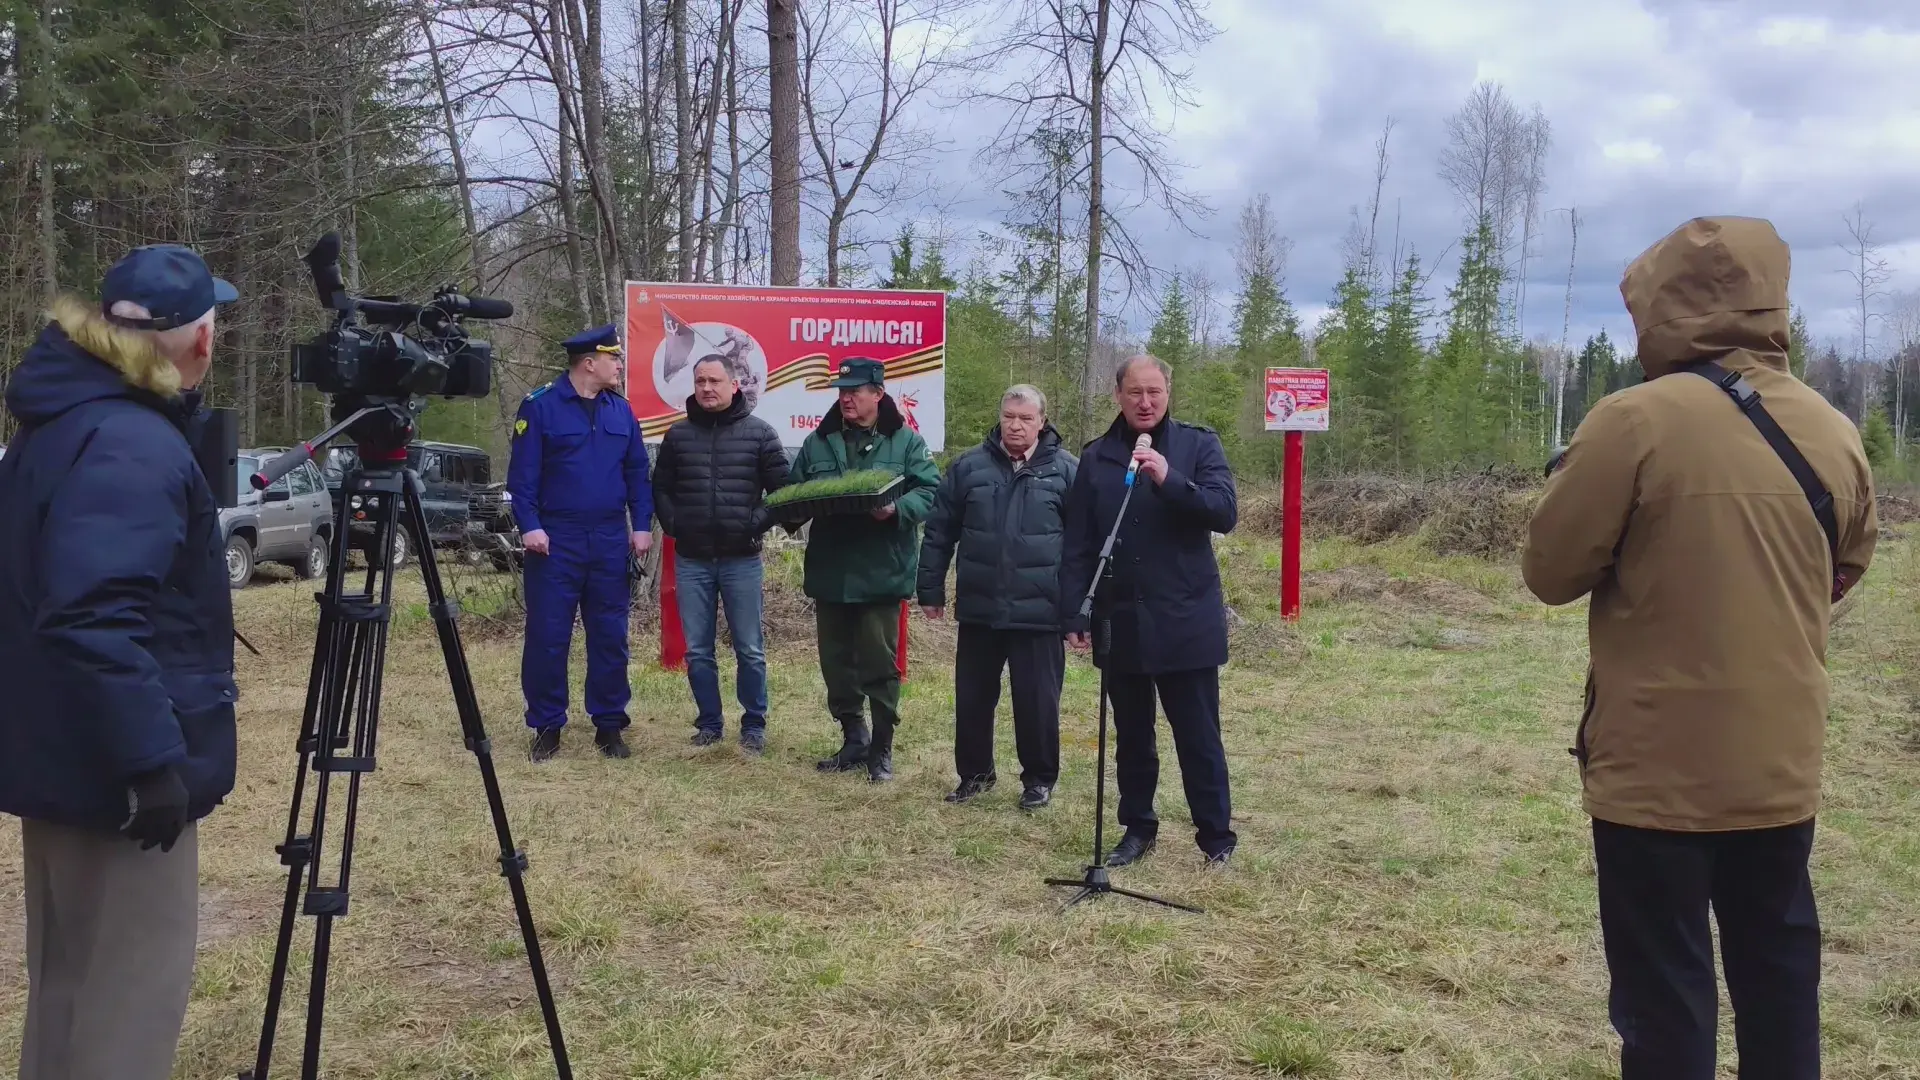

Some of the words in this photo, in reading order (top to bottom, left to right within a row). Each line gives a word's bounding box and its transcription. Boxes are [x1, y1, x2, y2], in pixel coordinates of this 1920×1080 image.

[726, 294, 760, 302] ХОЗЯЙСТВА
[872, 298, 910, 306] СМОЛЕНСКОЙ
[790, 317, 923, 346] ГОРДИМСЯ!
[790, 414, 822, 429] 1945
